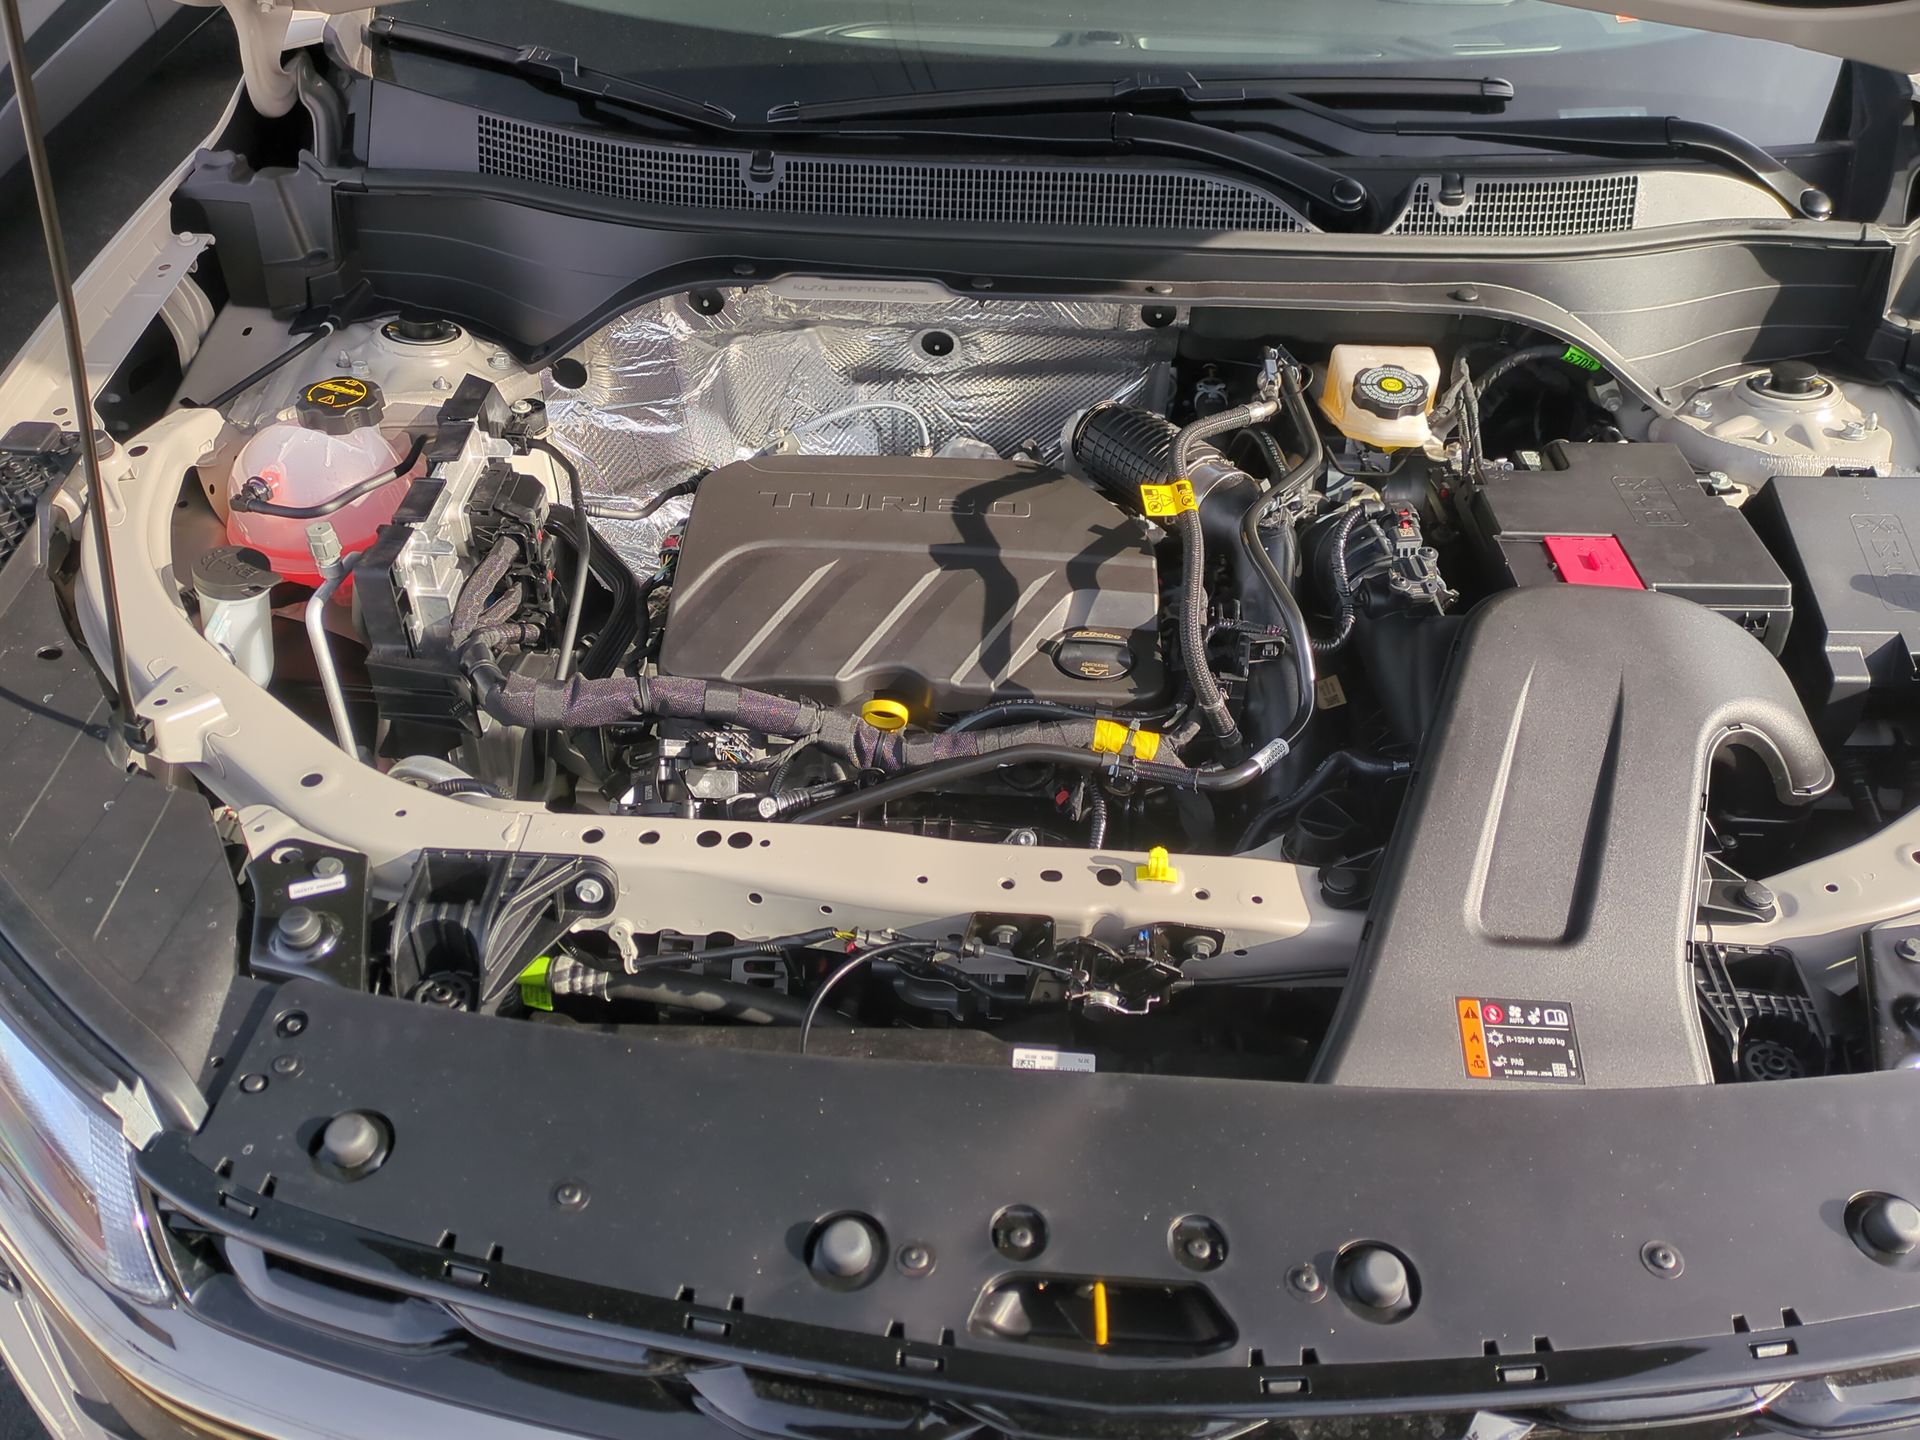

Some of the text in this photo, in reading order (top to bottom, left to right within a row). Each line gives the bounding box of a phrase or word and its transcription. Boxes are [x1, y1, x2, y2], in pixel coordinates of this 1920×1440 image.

[757, 490, 1031, 518] TURBO
[1072, 630, 1121, 639] ACDelco
[1509, 1017, 1525, 1025] AUTO
